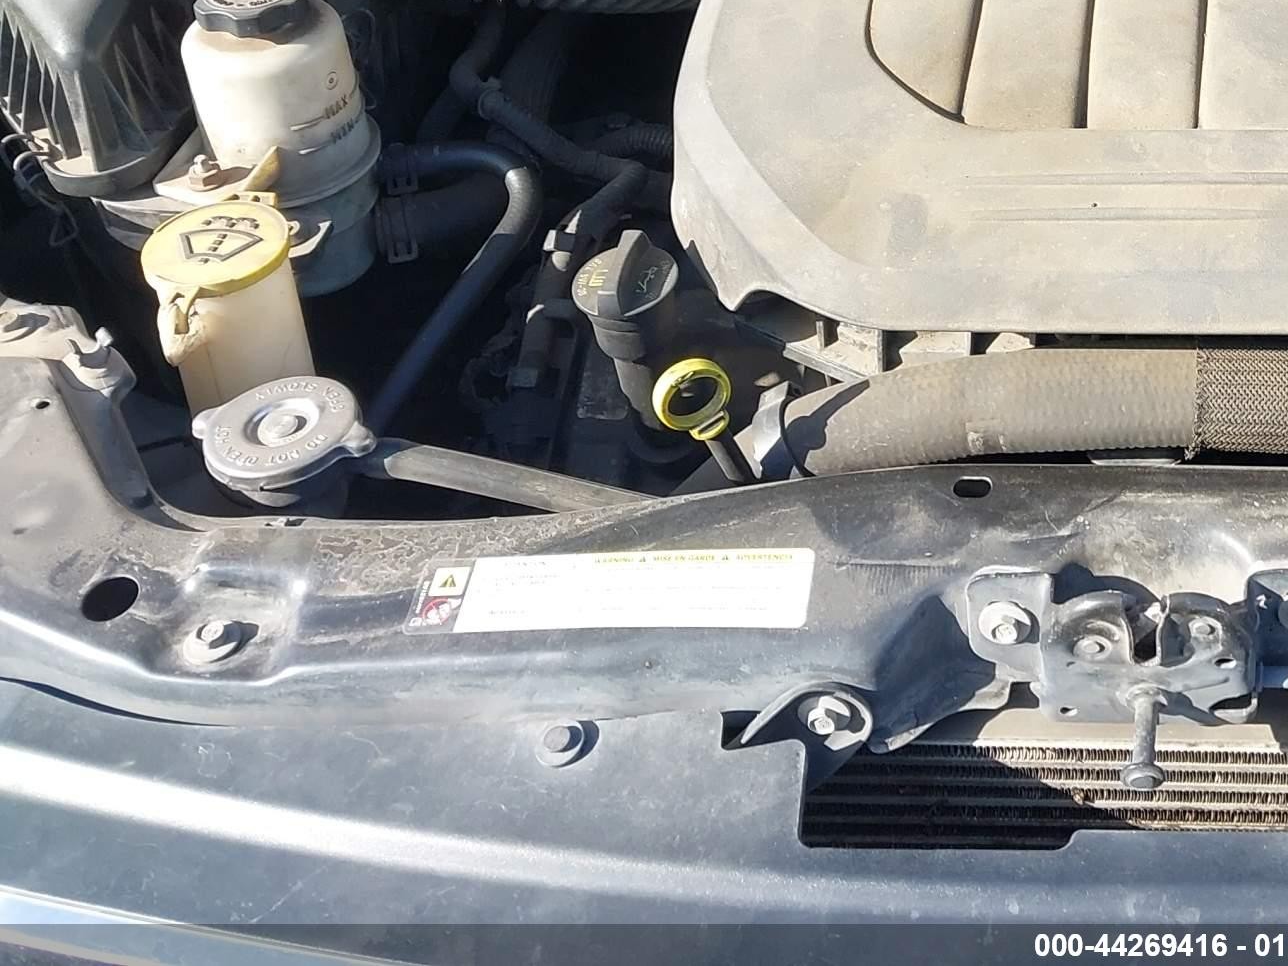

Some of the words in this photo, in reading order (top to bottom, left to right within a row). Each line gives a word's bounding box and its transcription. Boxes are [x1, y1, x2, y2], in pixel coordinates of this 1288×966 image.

[324, 94, 348, 120] MAX
[330, 117, 355, 144] MIN
[255, 381, 319, 401] SLOWLY
[322, 386, 346, 413] OPEN
[213, 425, 233, 445] HOT
[305, 433, 330, 451] DO
[222, 445, 259, 468] OPEN
[265, 448, 301, 468] NOT
